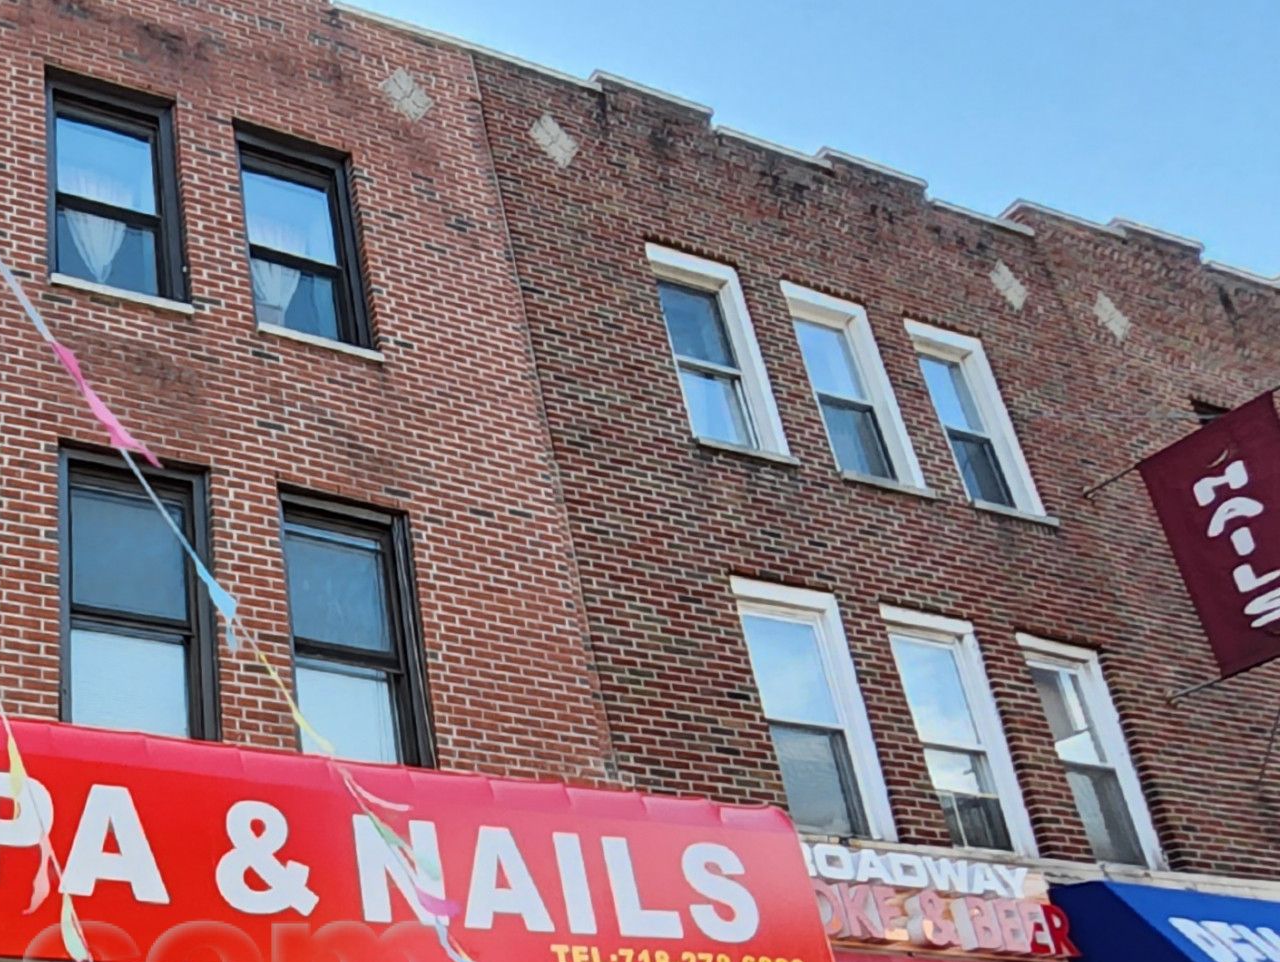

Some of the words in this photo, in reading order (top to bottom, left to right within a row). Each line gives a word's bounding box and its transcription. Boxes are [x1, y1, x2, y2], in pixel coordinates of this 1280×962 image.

[215, 800, 319, 917] &
[352, 812, 761, 944] NAILS
[800, 842, 1028, 900] OADWAY
[963, 894, 1081, 957] BEER
